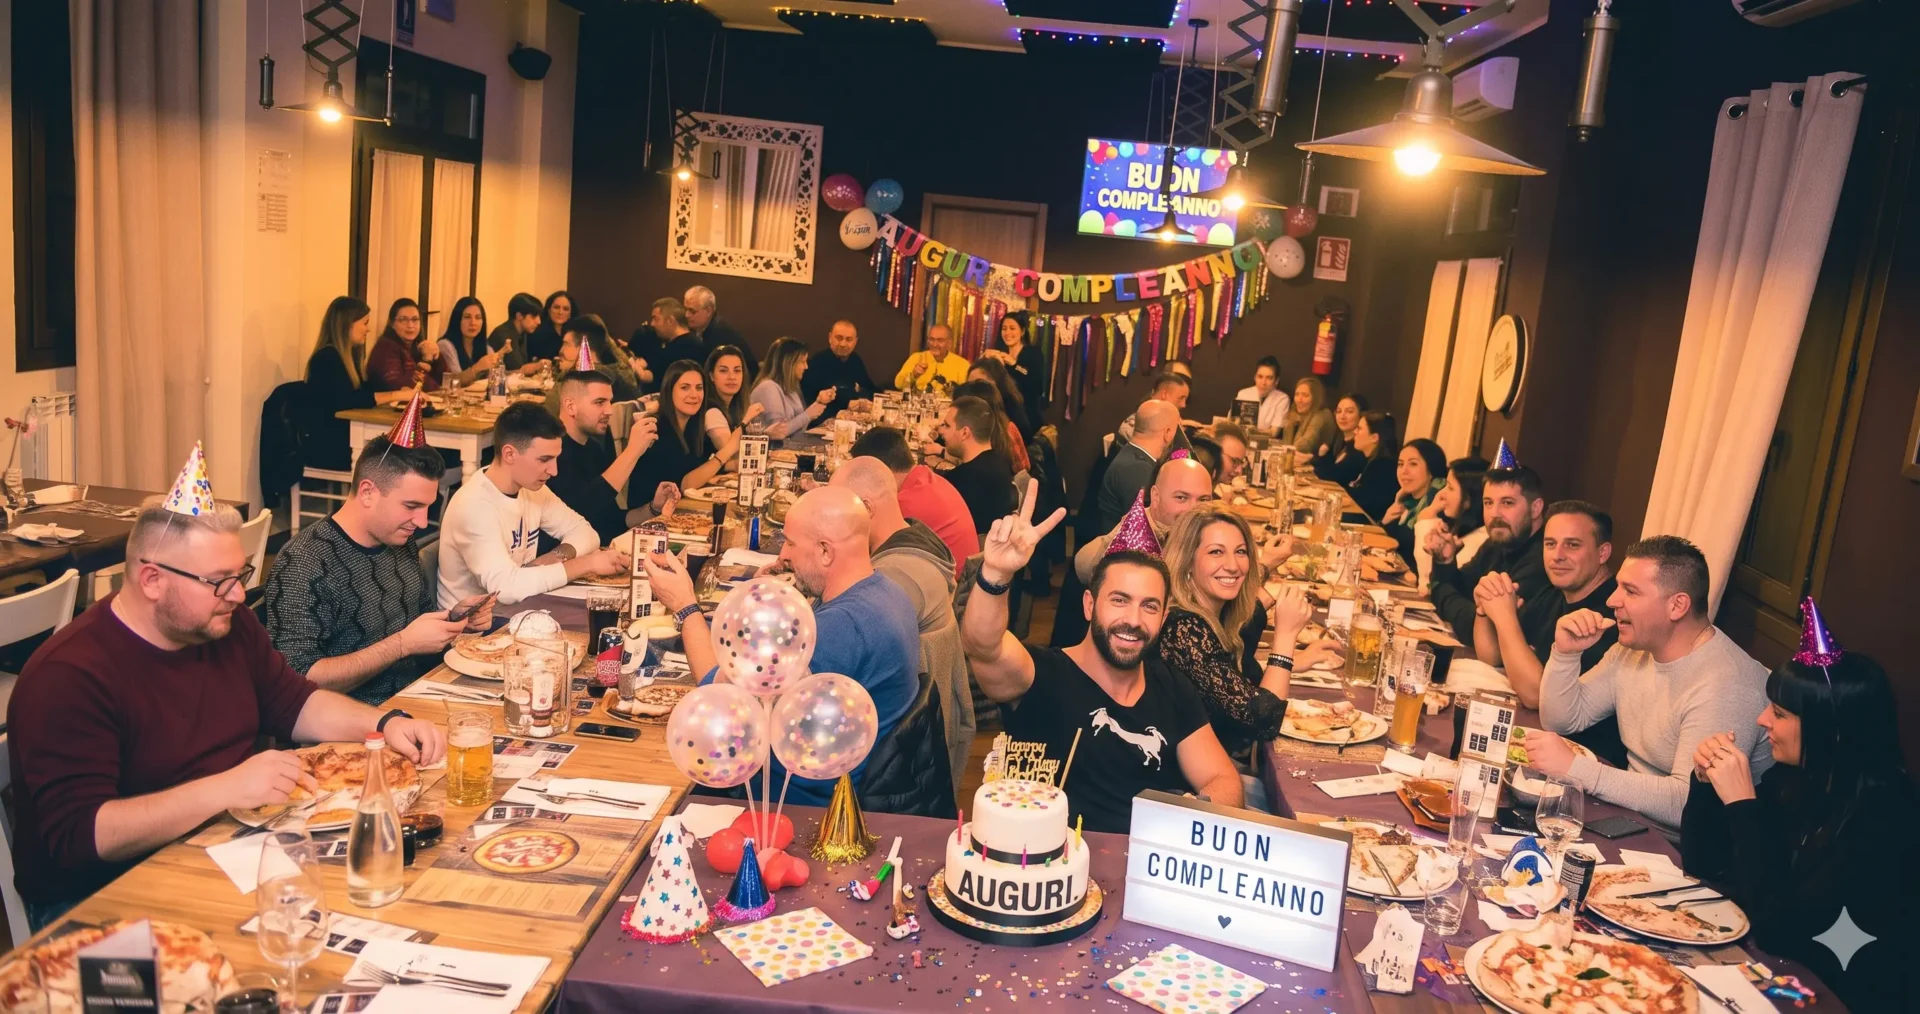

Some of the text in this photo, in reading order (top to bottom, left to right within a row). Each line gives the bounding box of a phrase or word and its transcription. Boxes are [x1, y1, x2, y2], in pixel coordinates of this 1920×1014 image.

[1127, 162, 1200, 193] BUON
[1097, 188, 1222, 218] COMPLEANNO
[1014, 244, 1262, 303] COMPLEANNO
[1191, 820, 1271, 862] BUON
[957, 869, 1079, 912] AUGURI.
[1147, 852, 1324, 916] COMPLEANNO
